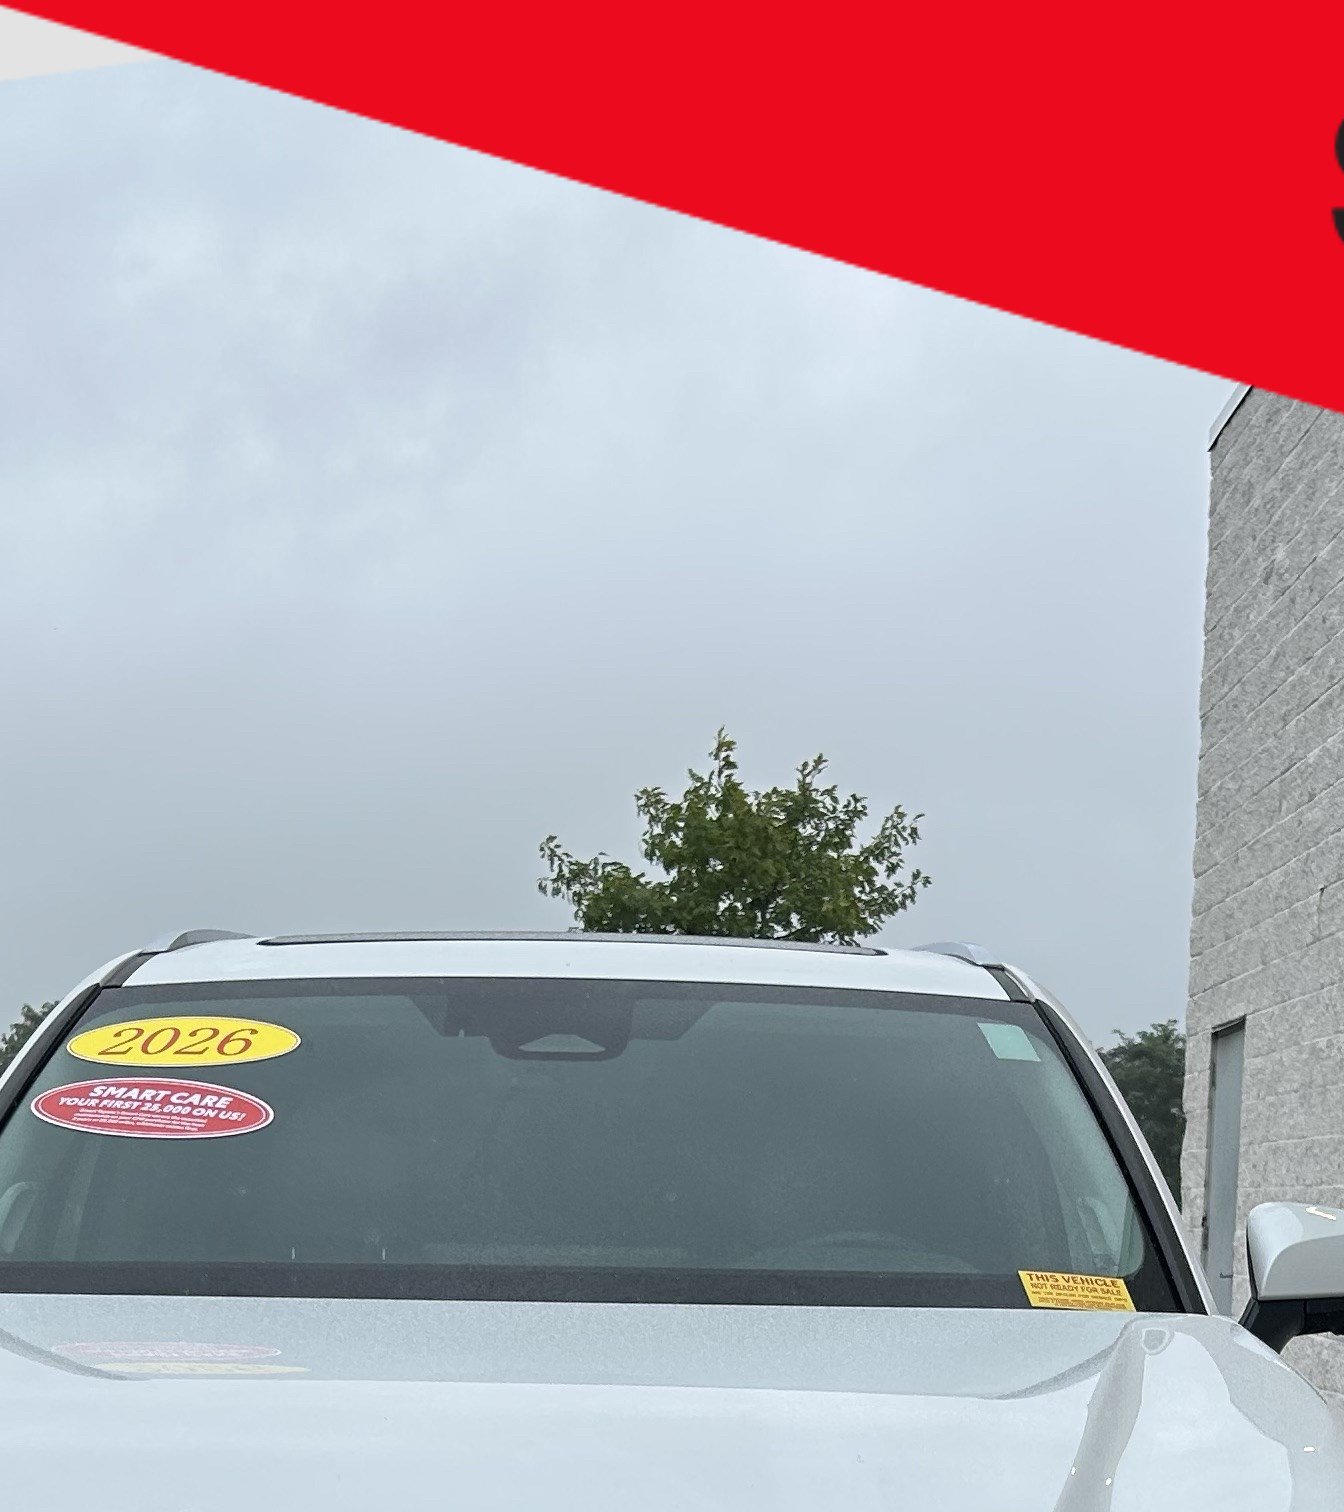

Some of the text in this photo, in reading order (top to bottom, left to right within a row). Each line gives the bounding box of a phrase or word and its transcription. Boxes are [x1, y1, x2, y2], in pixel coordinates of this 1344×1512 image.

[97, 1027, 259, 1056] 2026
[58, 1096, 102, 1107] YOUR
[100, 1099, 143, 1110] FIRST
[140, 1103, 192, 1115] 25,000
[192, 1107, 219, 1118] ON
[218, 1110, 247, 1121] US!
[89, 1086, 234, 1109] SMART CARE
[1026, 1273, 1120, 1288] THIS VEHICLE
[1030, 1282, 1123, 1296] NOT READY FOR SALE
